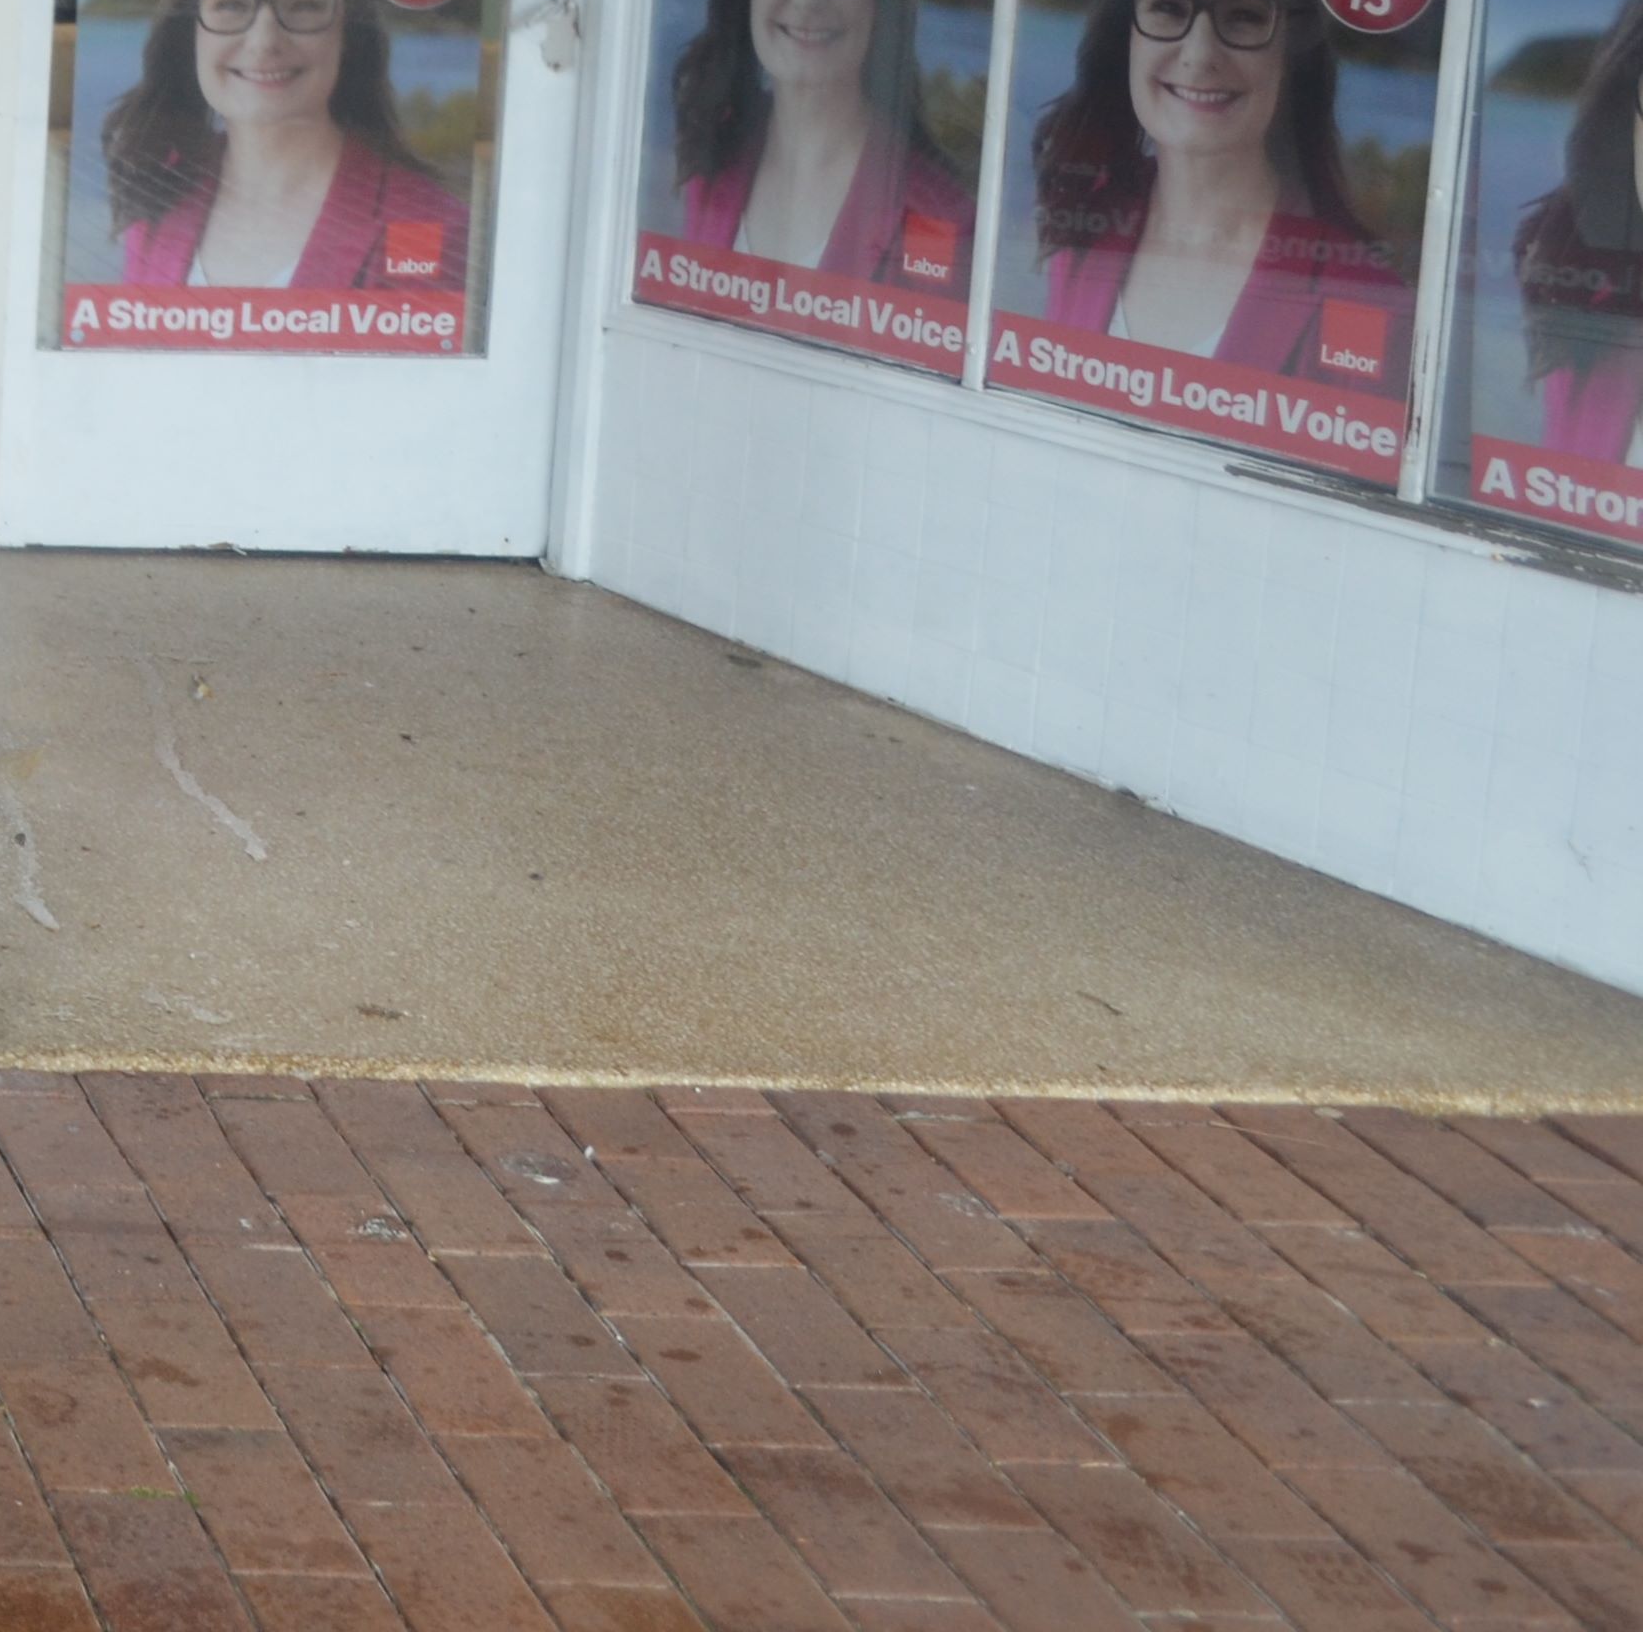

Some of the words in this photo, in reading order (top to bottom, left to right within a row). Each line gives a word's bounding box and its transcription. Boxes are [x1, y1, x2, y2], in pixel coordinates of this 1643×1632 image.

[387, 256, 436, 274] Labor
[904, 254, 948, 279] Labor
[72, 301, 100, 330] A
[107, 300, 234, 339] Strong
[241, 303, 339, 334] Local
[348, 304, 455, 336] Voice
[640, 249, 662, 281] A
[669, 255, 770, 314] Strong
[775, 278, 861, 328] Local
[868, 299, 962, 352] Voice
[1321, 344, 1378, 373] Labor
[994, 329, 1021, 367] A
[1029, 337, 1154, 407] Strong
[1161, 368, 1266, 426] Local
[1276, 394, 1397, 456] Voice
[1481, 458, 1516, 499] A
